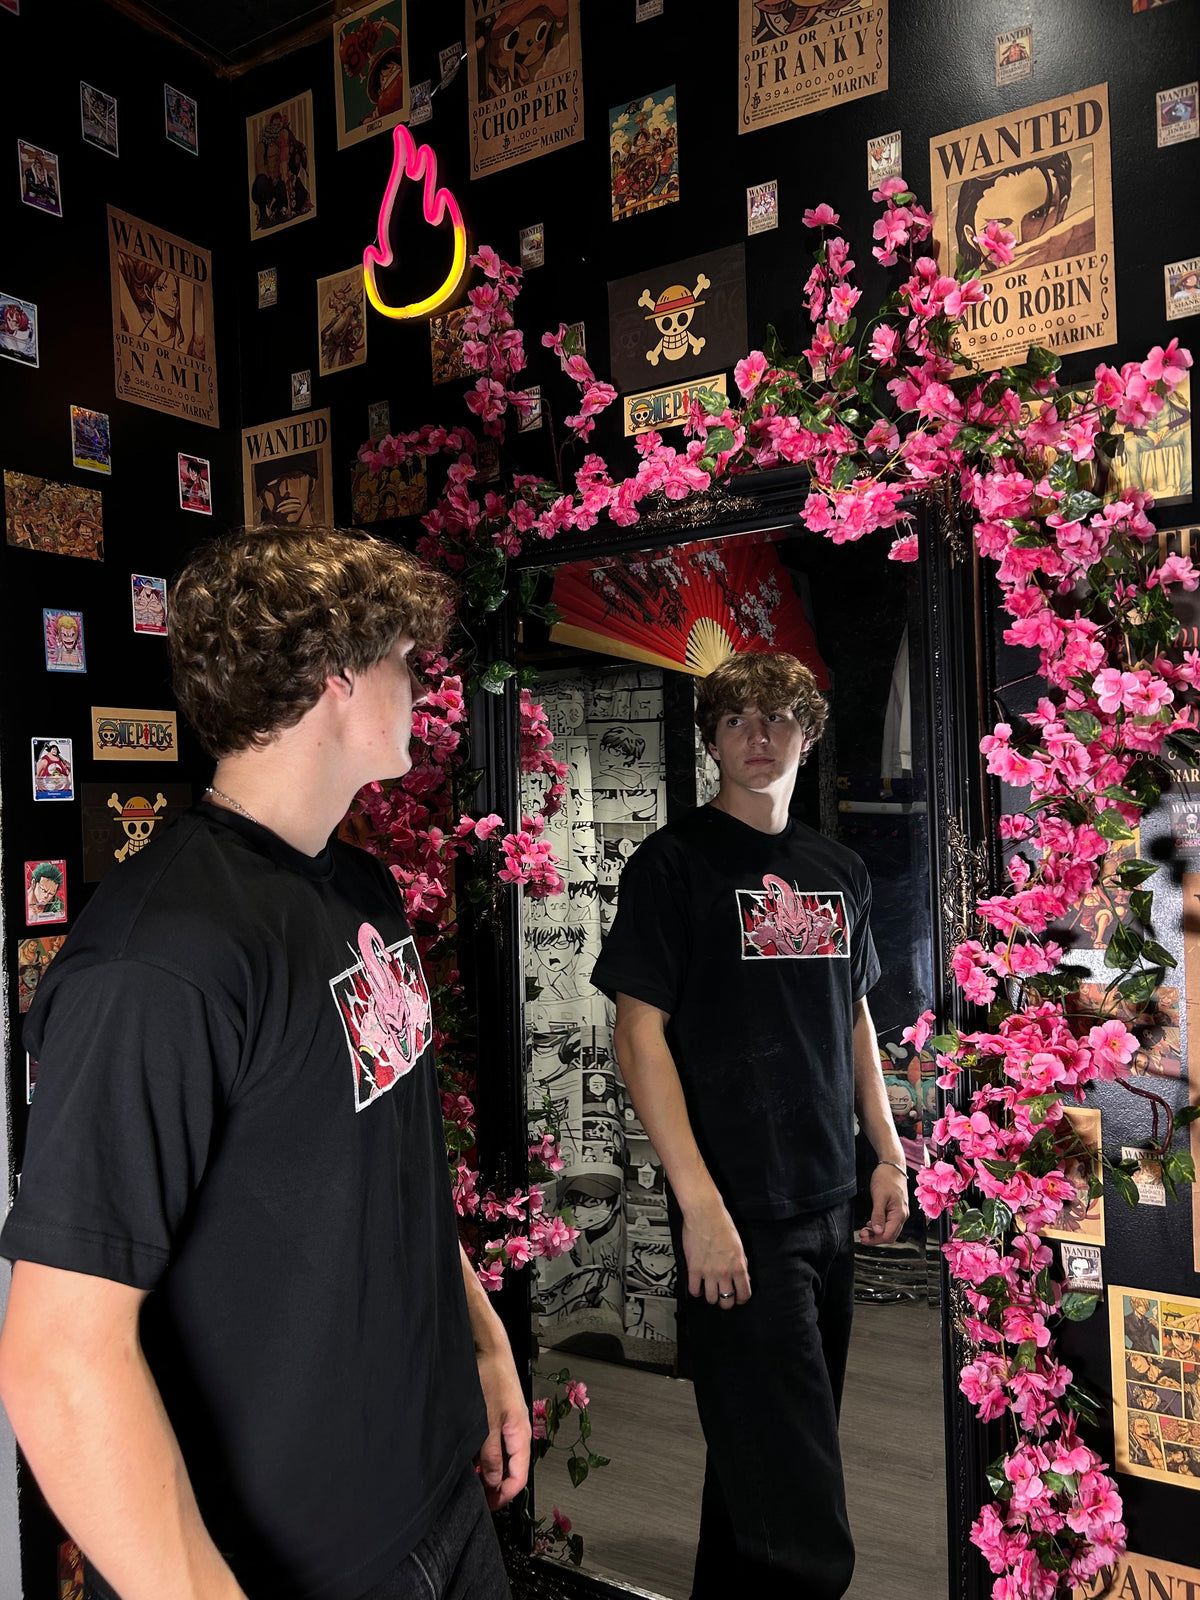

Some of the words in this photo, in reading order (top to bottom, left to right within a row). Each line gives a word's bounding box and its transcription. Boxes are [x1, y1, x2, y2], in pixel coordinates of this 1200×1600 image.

[751, 40, 788, 61] DEAD
[798, 30, 817, 45] OR
[827, 10, 875, 37] ALIVE
[997, 27, 1031, 44] WANTED
[757, 28, 868, 89] FRANKY
[478, 98, 506, 117] DEAD
[513, 89, 528, 104] OR
[536, 71, 572, 95] ALIVE
[832, 71, 878, 98] MARINE
[1158, 86, 1198, 102] WANTED
[482, 88, 568, 140] CHOPPER
[540, 124, 576, 148] MARINE
[869, 134, 900, 149] WANTED
[935, 99, 1103, 180] WANTED
[749, 182, 777, 197] WANTED
[110, 215, 208, 282] WANTED
[1005, 273, 1028, 290] OR
[1040, 256, 1098, 281] ALIVE
[955, 296, 1009, 335] NICO
[1018, 274, 1092, 320] ROBIN
[1048, 321, 1105, 348] MARINE
[121, 334, 150, 352] DEAD
[156, 347, 170, 360] OR
[176, 355, 208, 373] ALIVE
[130, 350, 200, 393] NAMI
[181, 402, 212, 421] MARINE
[245, 418, 328, 461] WANTED
[135, 722, 173, 746] PIECE
[1063, 1246, 1100, 1259] WANTED
